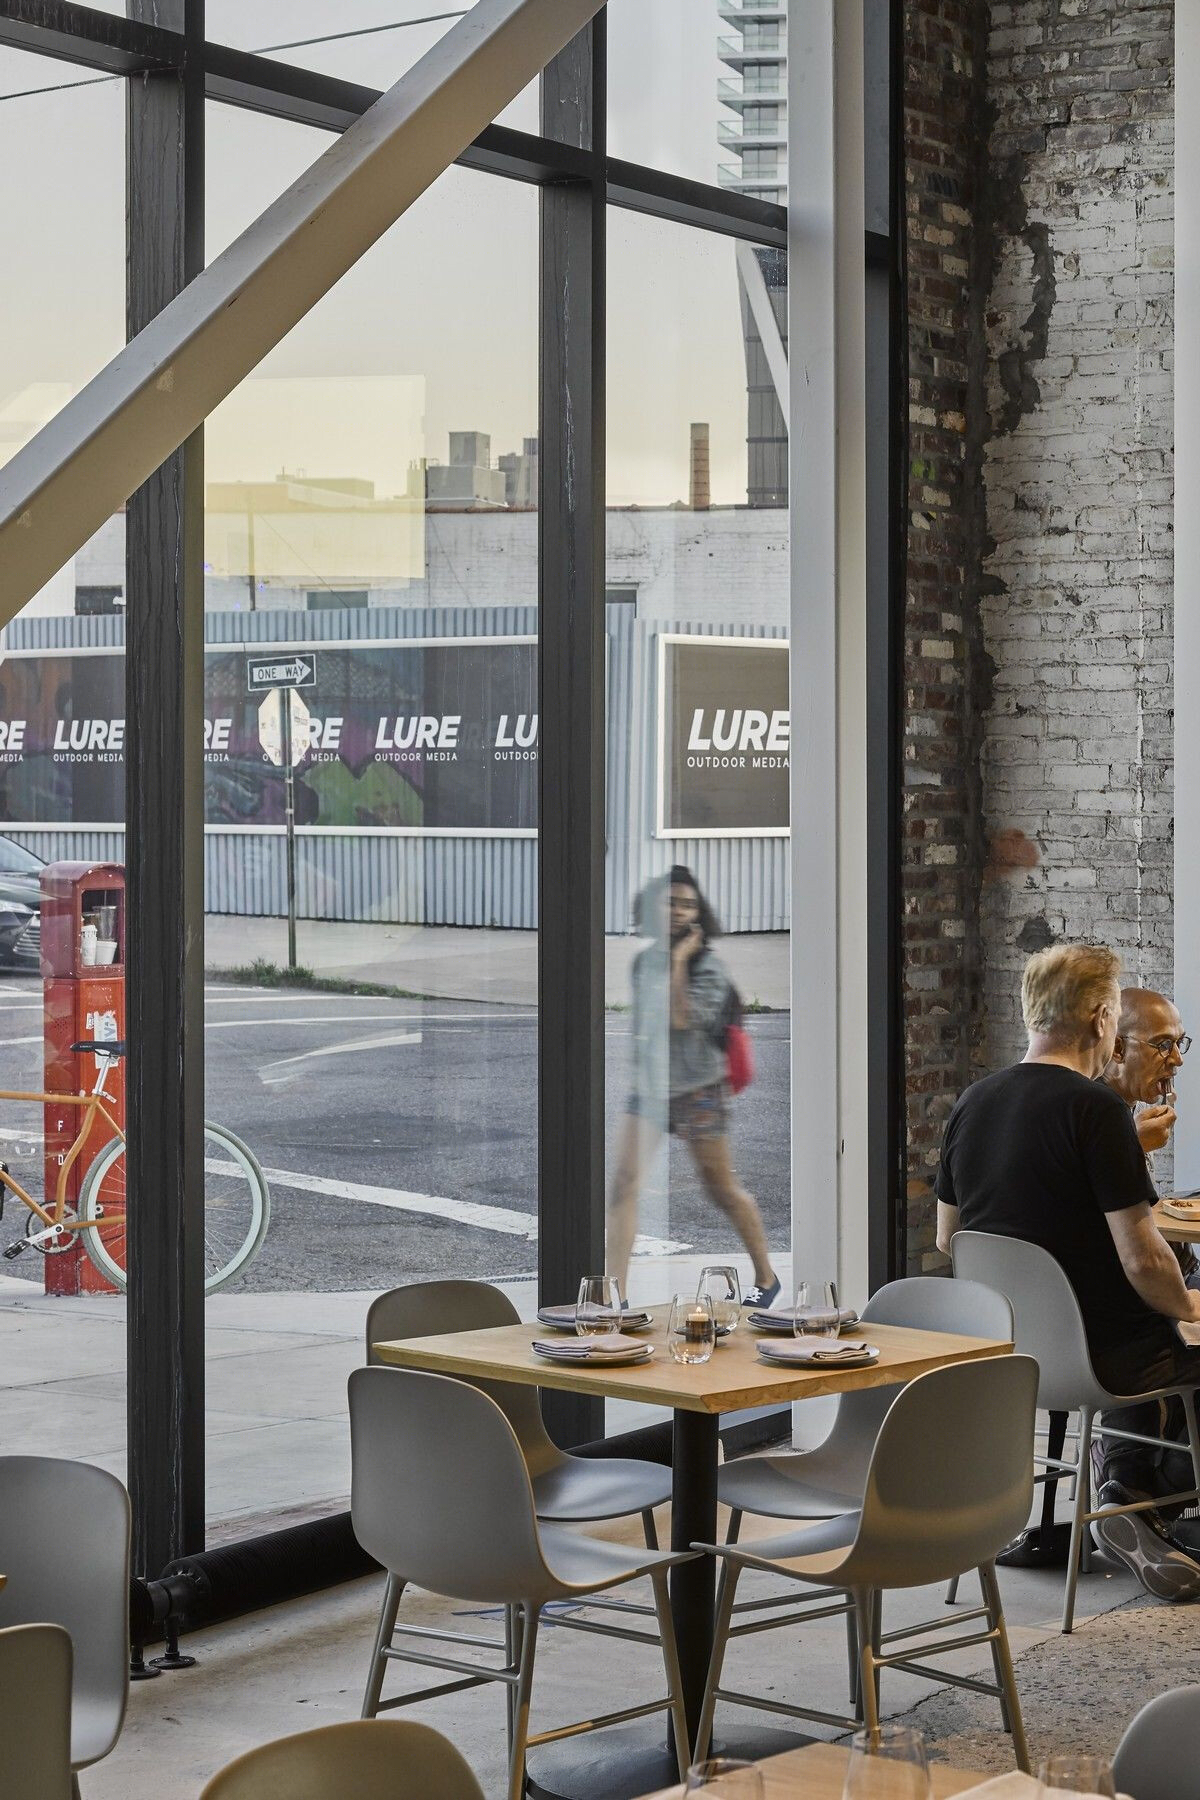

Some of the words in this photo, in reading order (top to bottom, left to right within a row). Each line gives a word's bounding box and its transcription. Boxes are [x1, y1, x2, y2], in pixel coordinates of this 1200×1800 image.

[257, 667, 277, 680] ONE
[285, 664, 304, 677] WAY
[53, 719, 126, 750] LURE
[309, 717, 344, 749] RE
[375, 716, 462, 749] LURE
[494, 714, 538, 748] LU
[687, 708, 789, 751] LURE
[53, 753, 94, 762] OUTDOOR
[97, 753, 124, 762] MEDIA
[311, 753, 341, 762] MEDIA
[374, 752, 422, 762] OUTDOOR
[426, 752, 458, 761] MEDIA
[494, 751, 538, 761] OUTDOO
[686, 756, 746, 768] OUTDOOR
[752, 756, 790, 768] MEDIA
